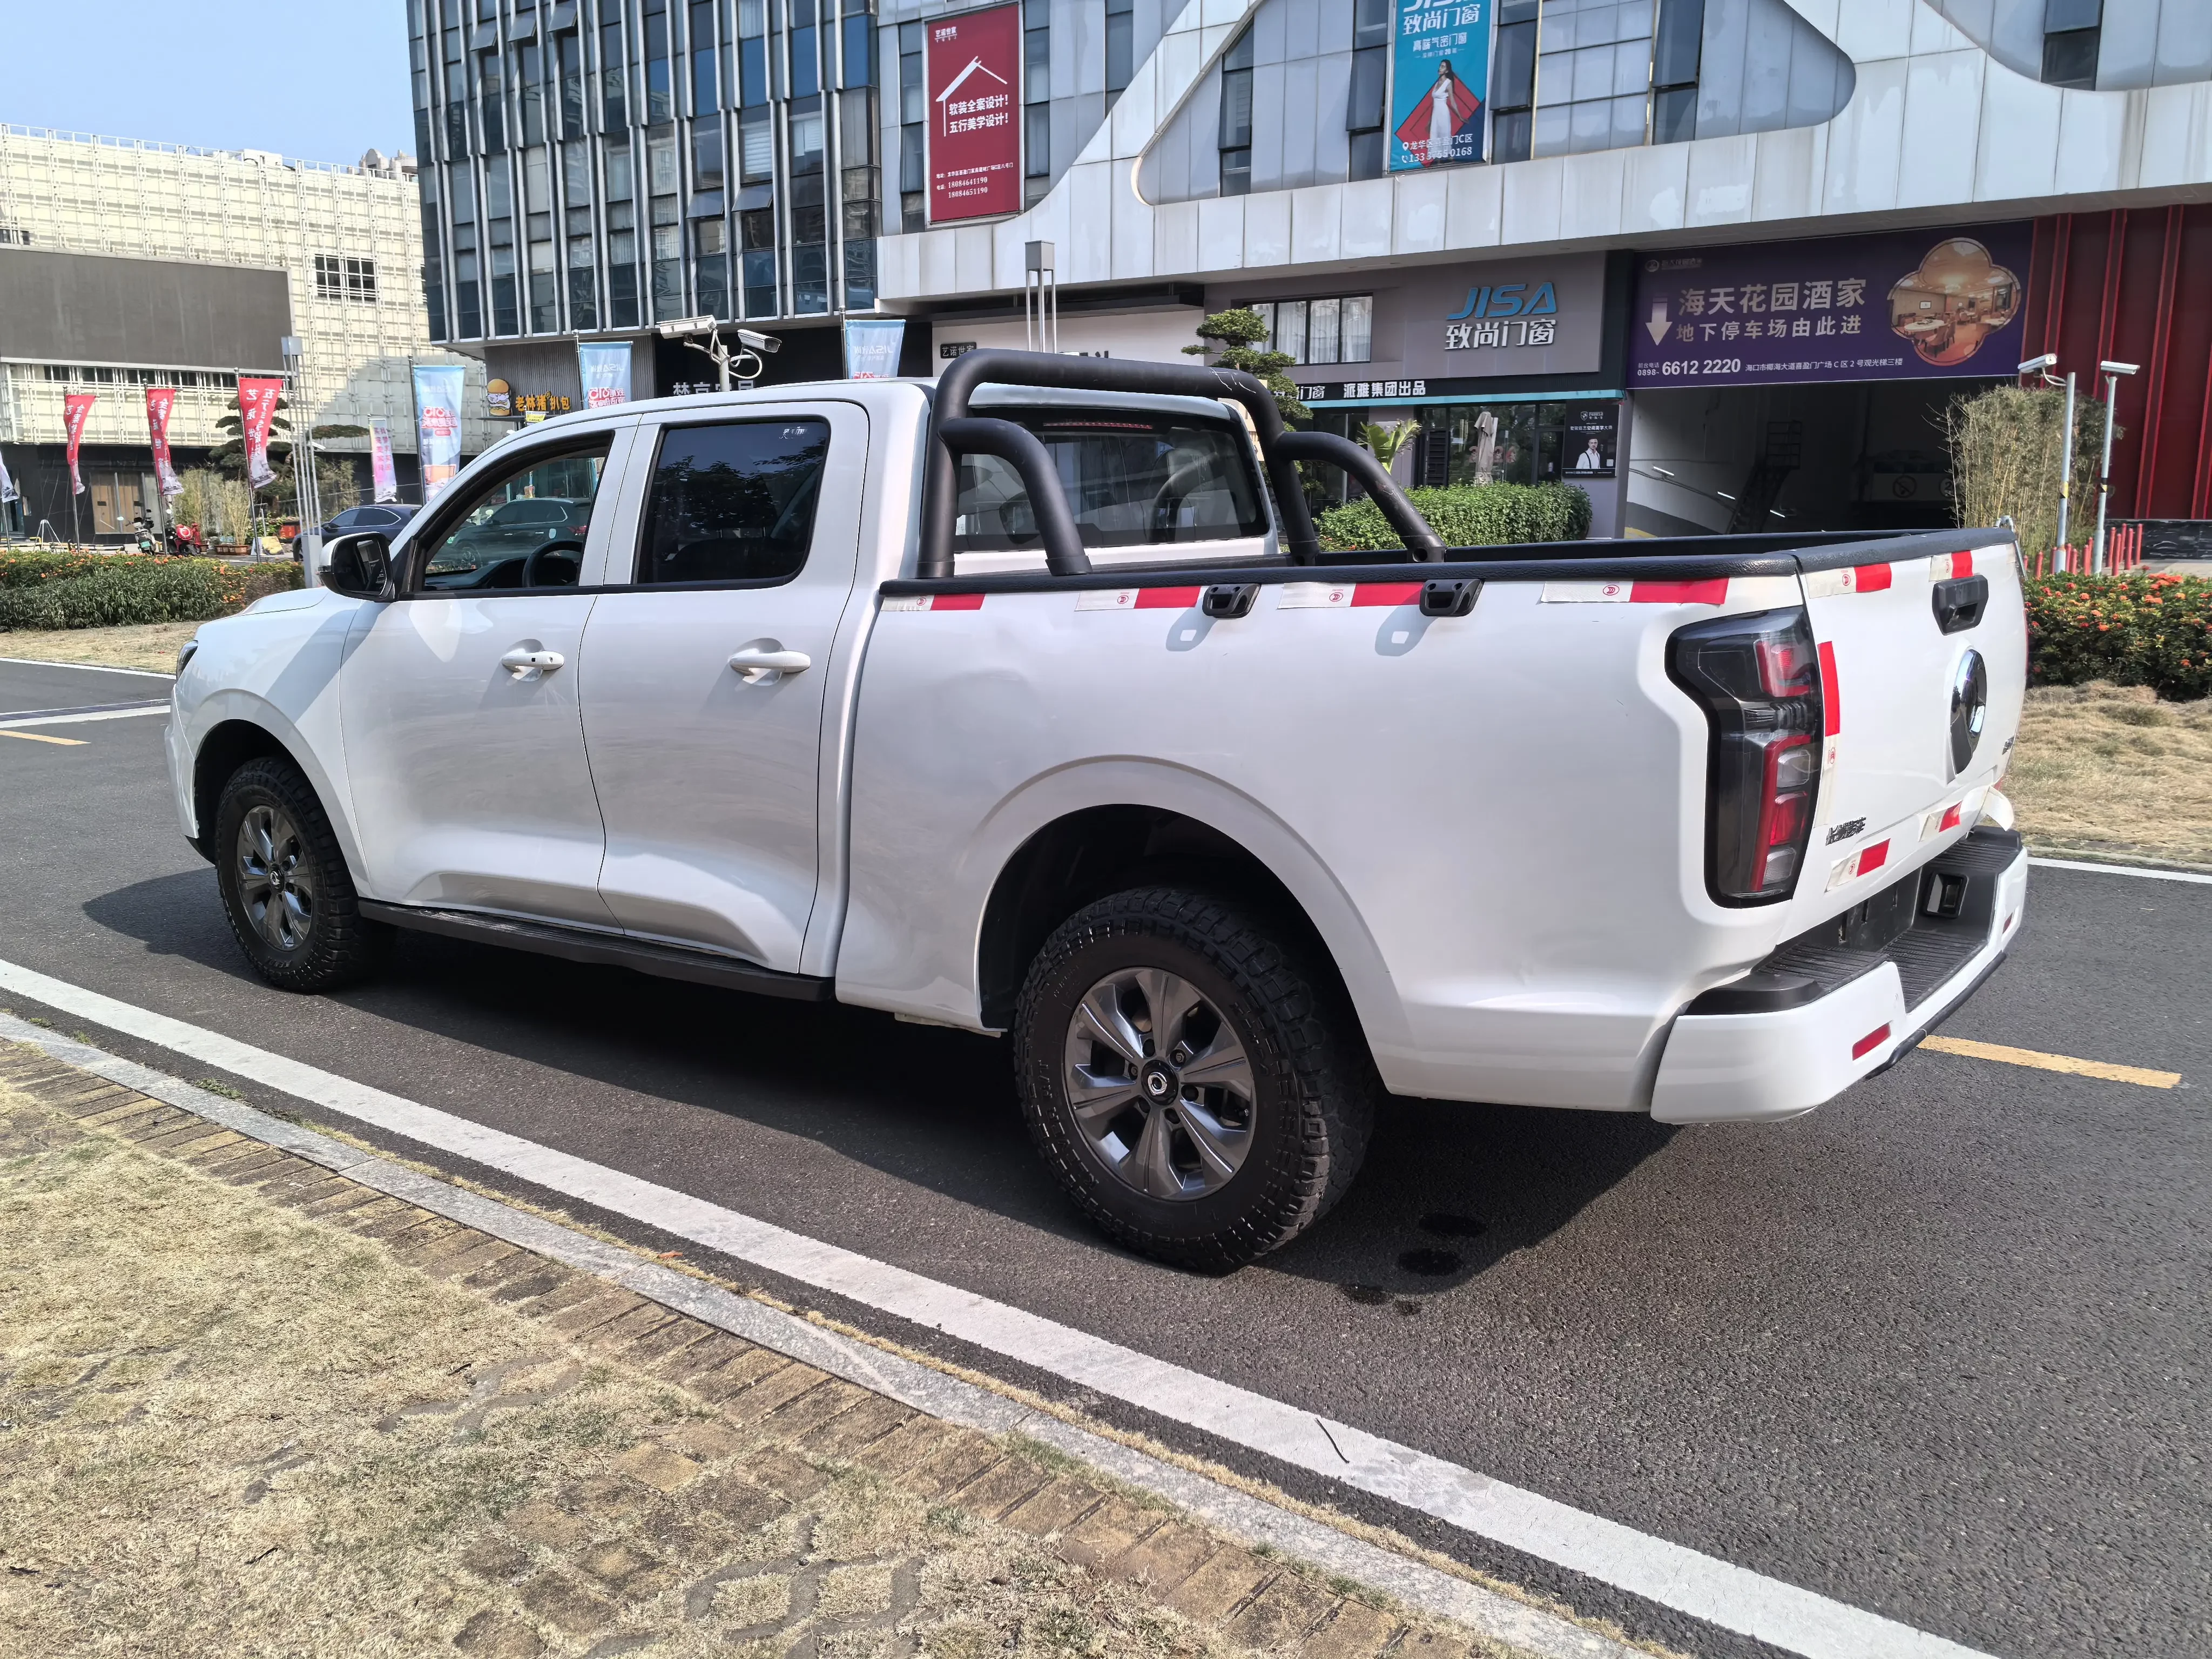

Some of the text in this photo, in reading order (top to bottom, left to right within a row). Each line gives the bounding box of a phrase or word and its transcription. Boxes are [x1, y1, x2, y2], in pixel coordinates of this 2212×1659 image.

[1402, 4, 1480, 36] 致尚门窗
[948, 177, 988, 188] 18084641190
[948, 187, 988, 198] 18084651190
[1446, 282, 1557, 320] JISA
[1678, 278, 1866, 316] 海天花园酒家
[1445, 319, 1556, 350] 致尚门窗
[1676, 315, 1862, 342] 地下停车场由此进
[1662, 359, 1741, 375] 6612 2220
[1344, 381, 1426, 399] 派雅集团出品
[515, 393, 570, 412] 老林猪扒包
